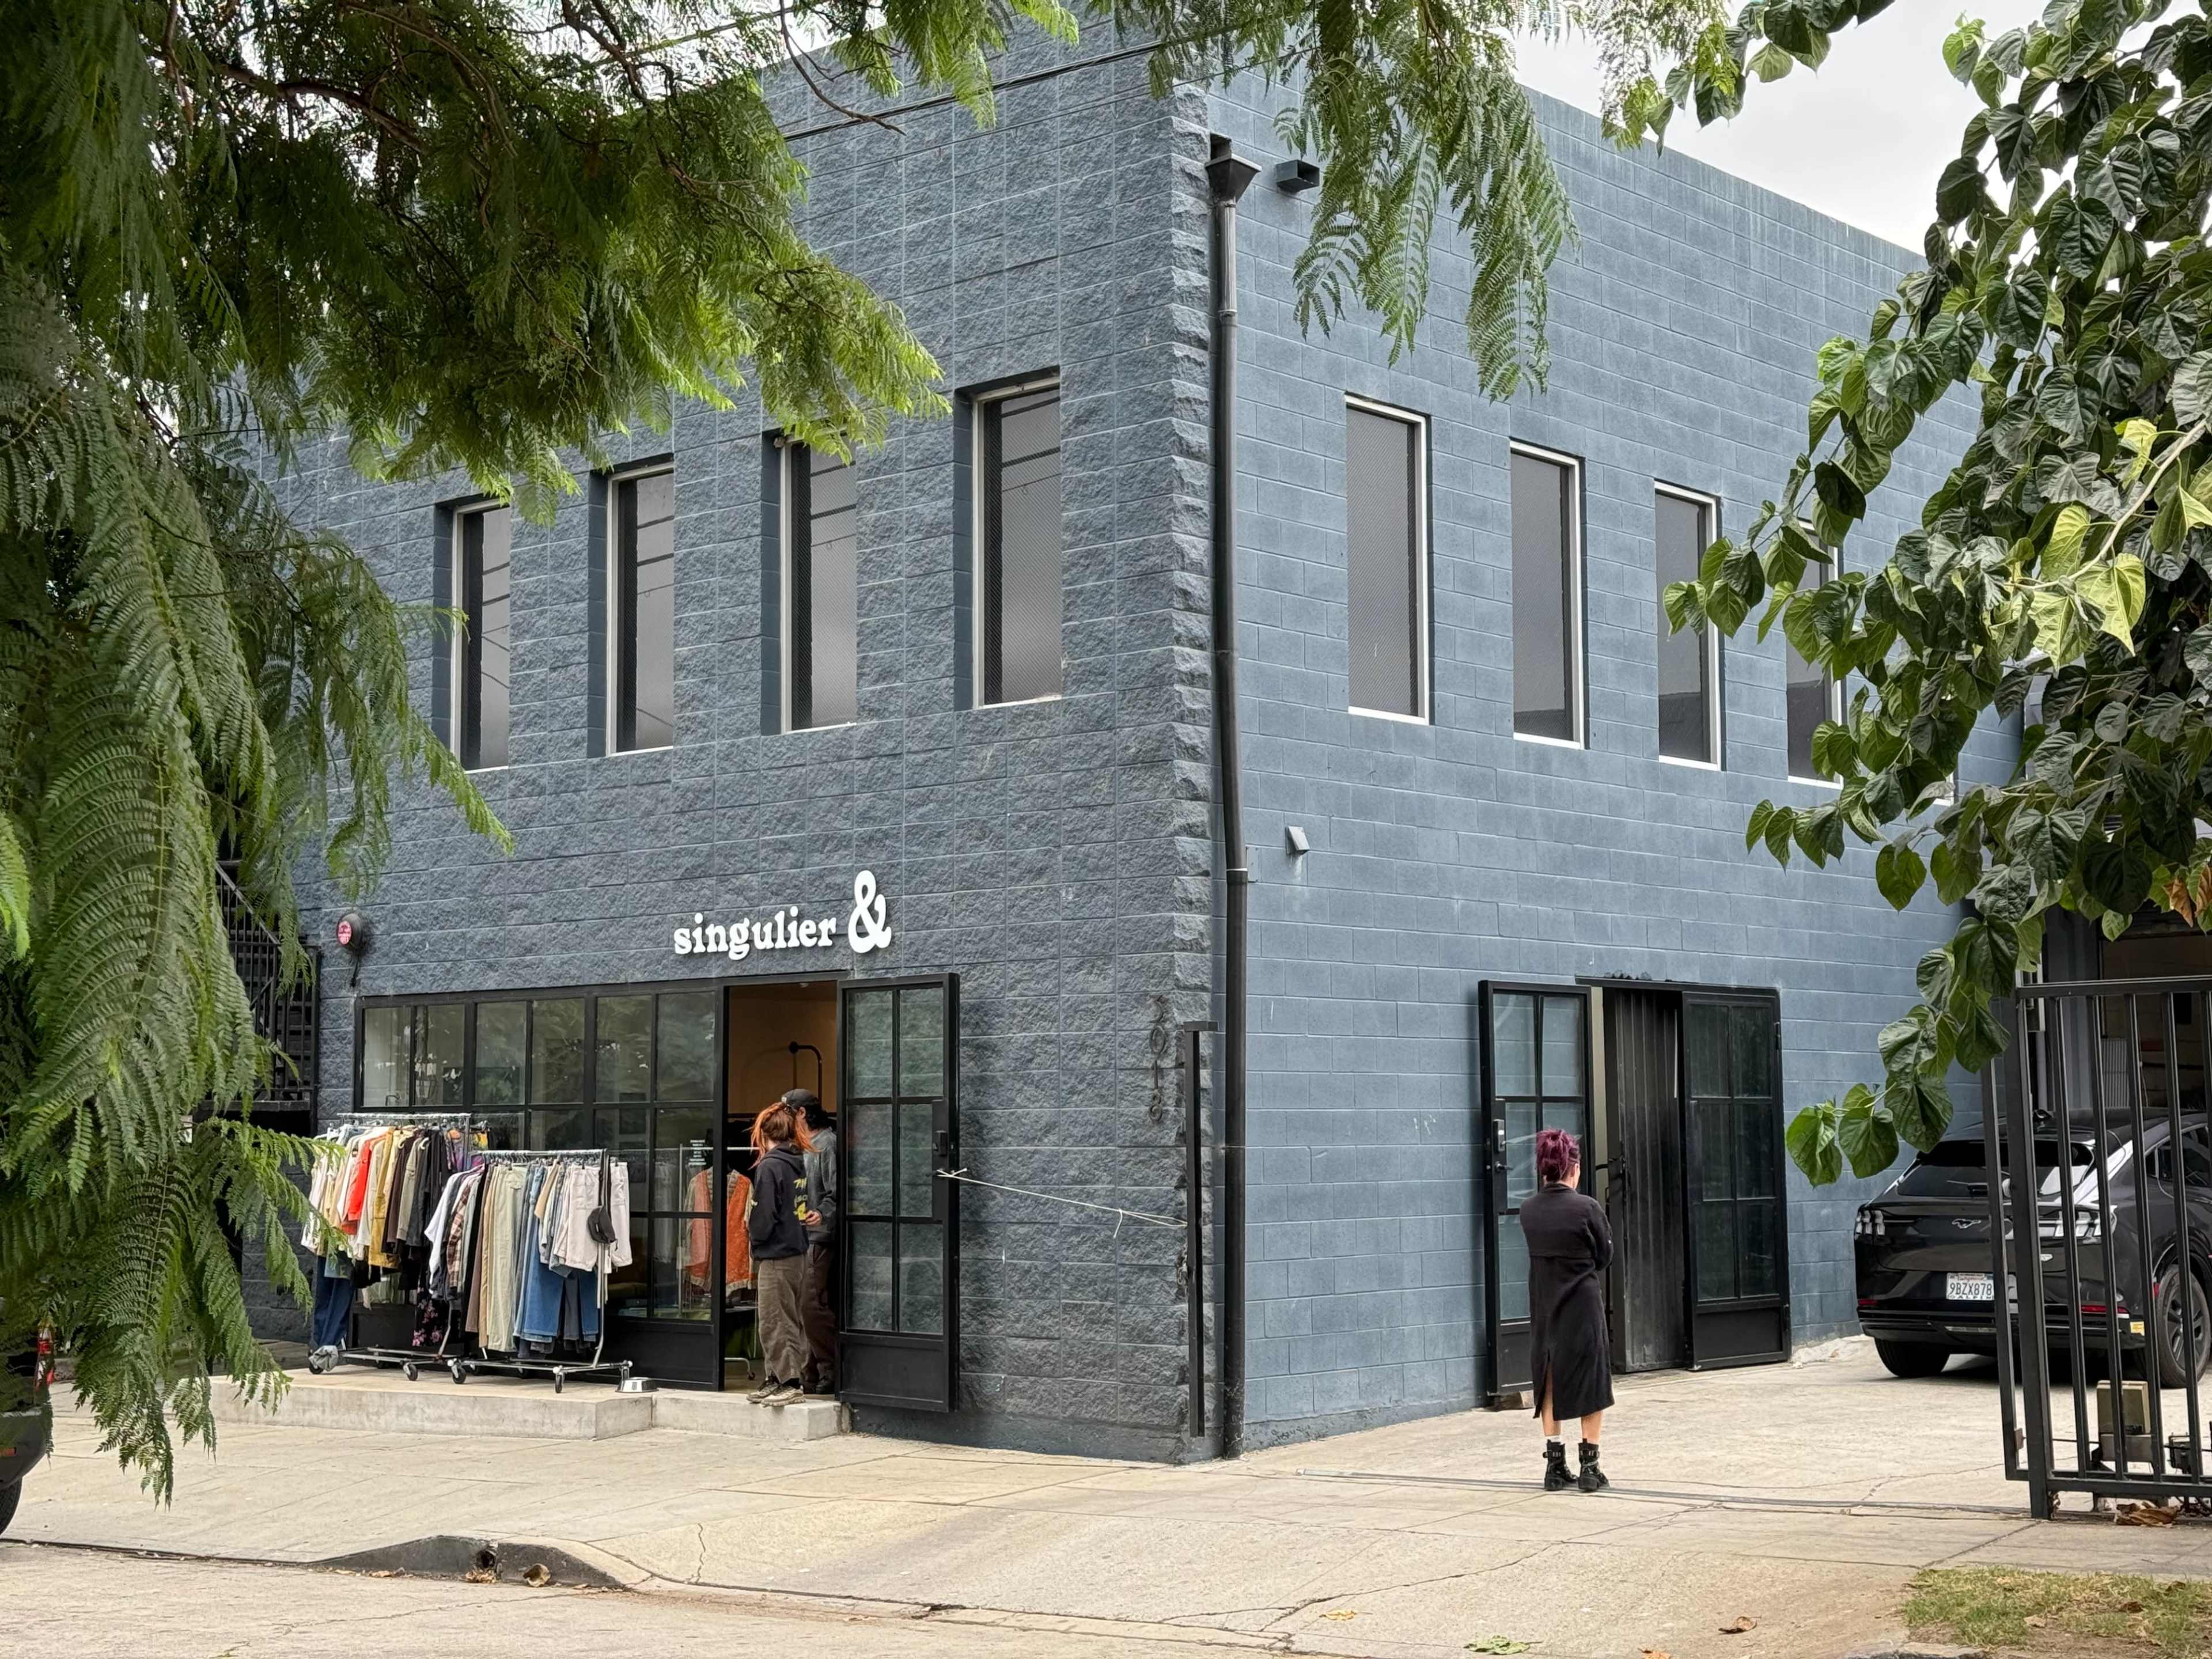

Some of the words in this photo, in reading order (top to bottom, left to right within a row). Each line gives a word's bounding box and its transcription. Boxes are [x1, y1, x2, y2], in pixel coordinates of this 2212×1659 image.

[673, 906, 837, 960] singulier
[848, 870, 892, 953] &
[1949, 1282, 1993, 1296] 9BZX878
